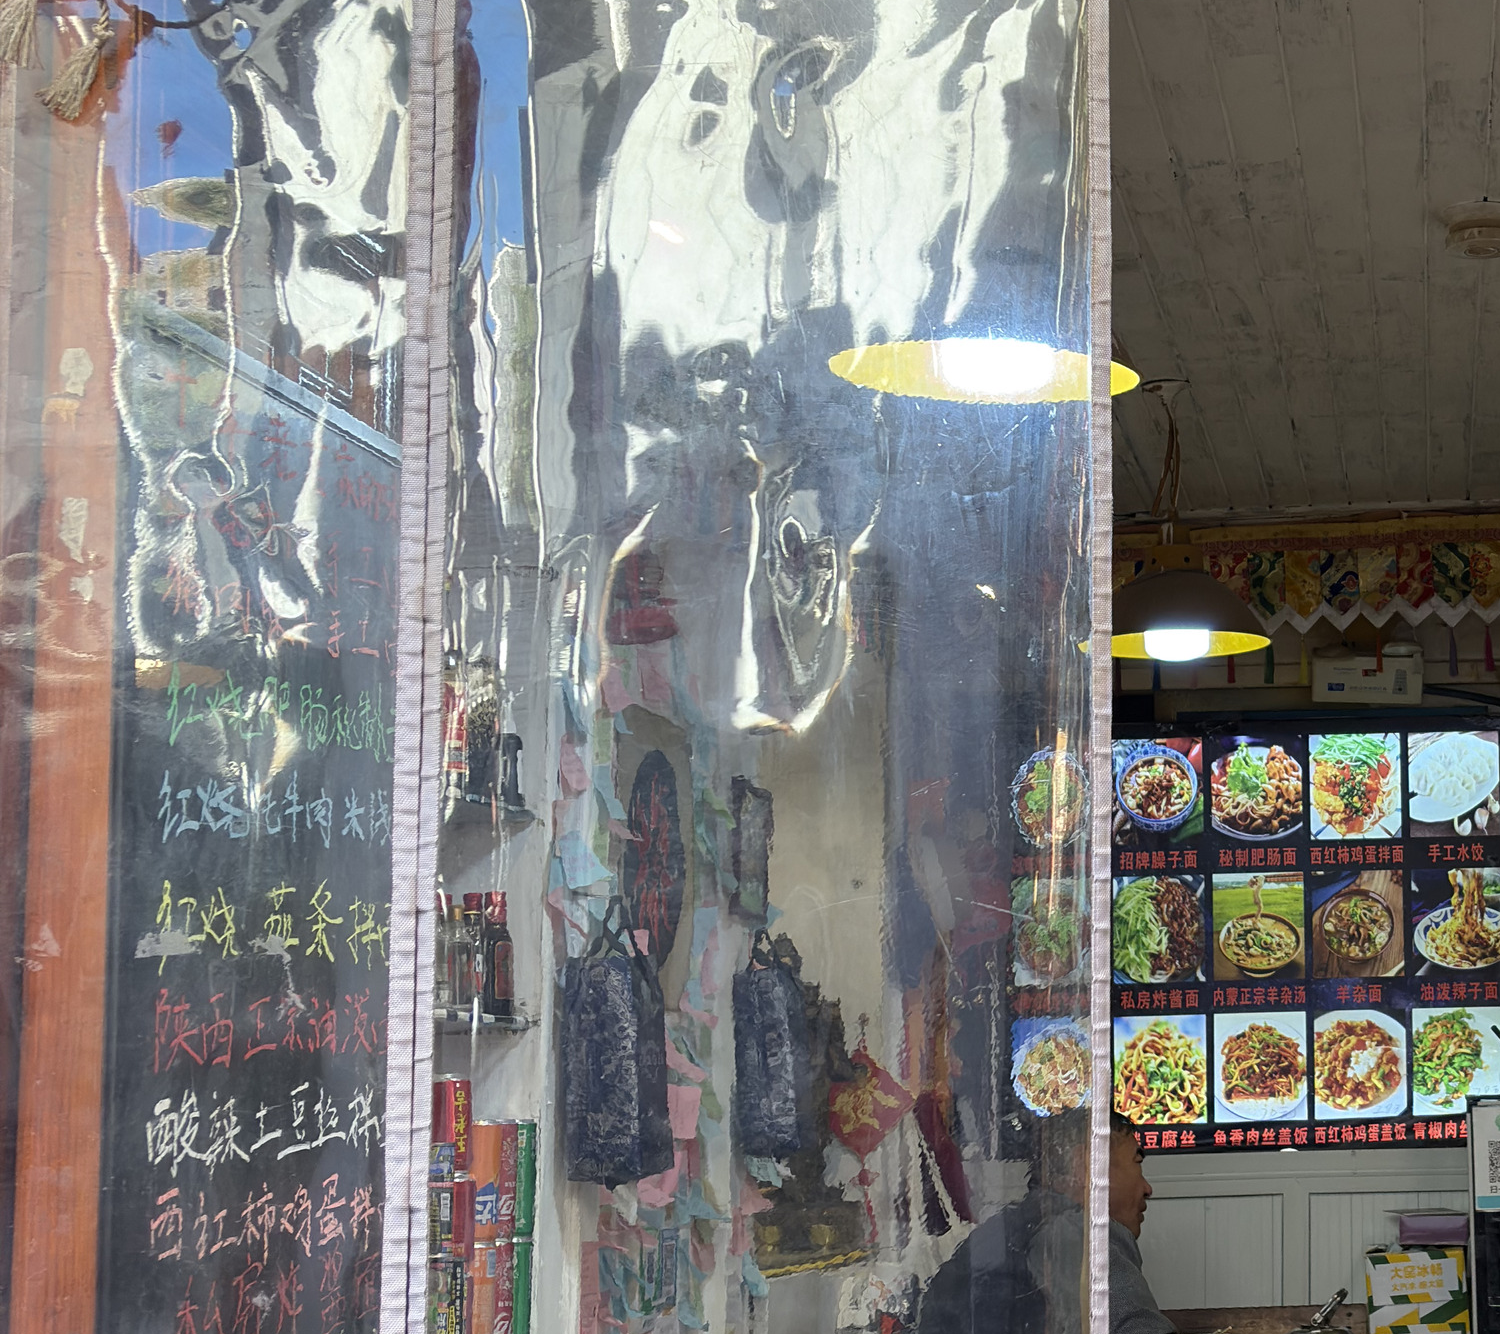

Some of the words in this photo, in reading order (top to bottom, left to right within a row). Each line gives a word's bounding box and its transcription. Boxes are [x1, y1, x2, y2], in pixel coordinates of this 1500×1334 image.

[1120, 850, 1198, 870] 招牌臊子面
[1219, 847, 1297, 867] 秘制肥肠面
[1310, 845, 1404, 864] 西红柿鸡蛋拌面
[1428, 843, 1484, 862] 手工水饺
[1120, 989, 1199, 1010] 私房炸酱面
[1213, 986, 1306, 1007] 内蒙正宗羊杂汤
[1336, 984, 1382, 1004] 羊杂面
[1420, 981, 1498, 1001] 油泼辣子面
[154, 988, 388, 1074] 陕西正宗油泼
[1214, 1127, 1308, 1147] 鱼香肉丝盖饭
[1314, 1123, 1407, 1144] 西红柿鸡蛋盖饭
[150, 1173, 385, 1267] 西红柿鸡蛋拌
